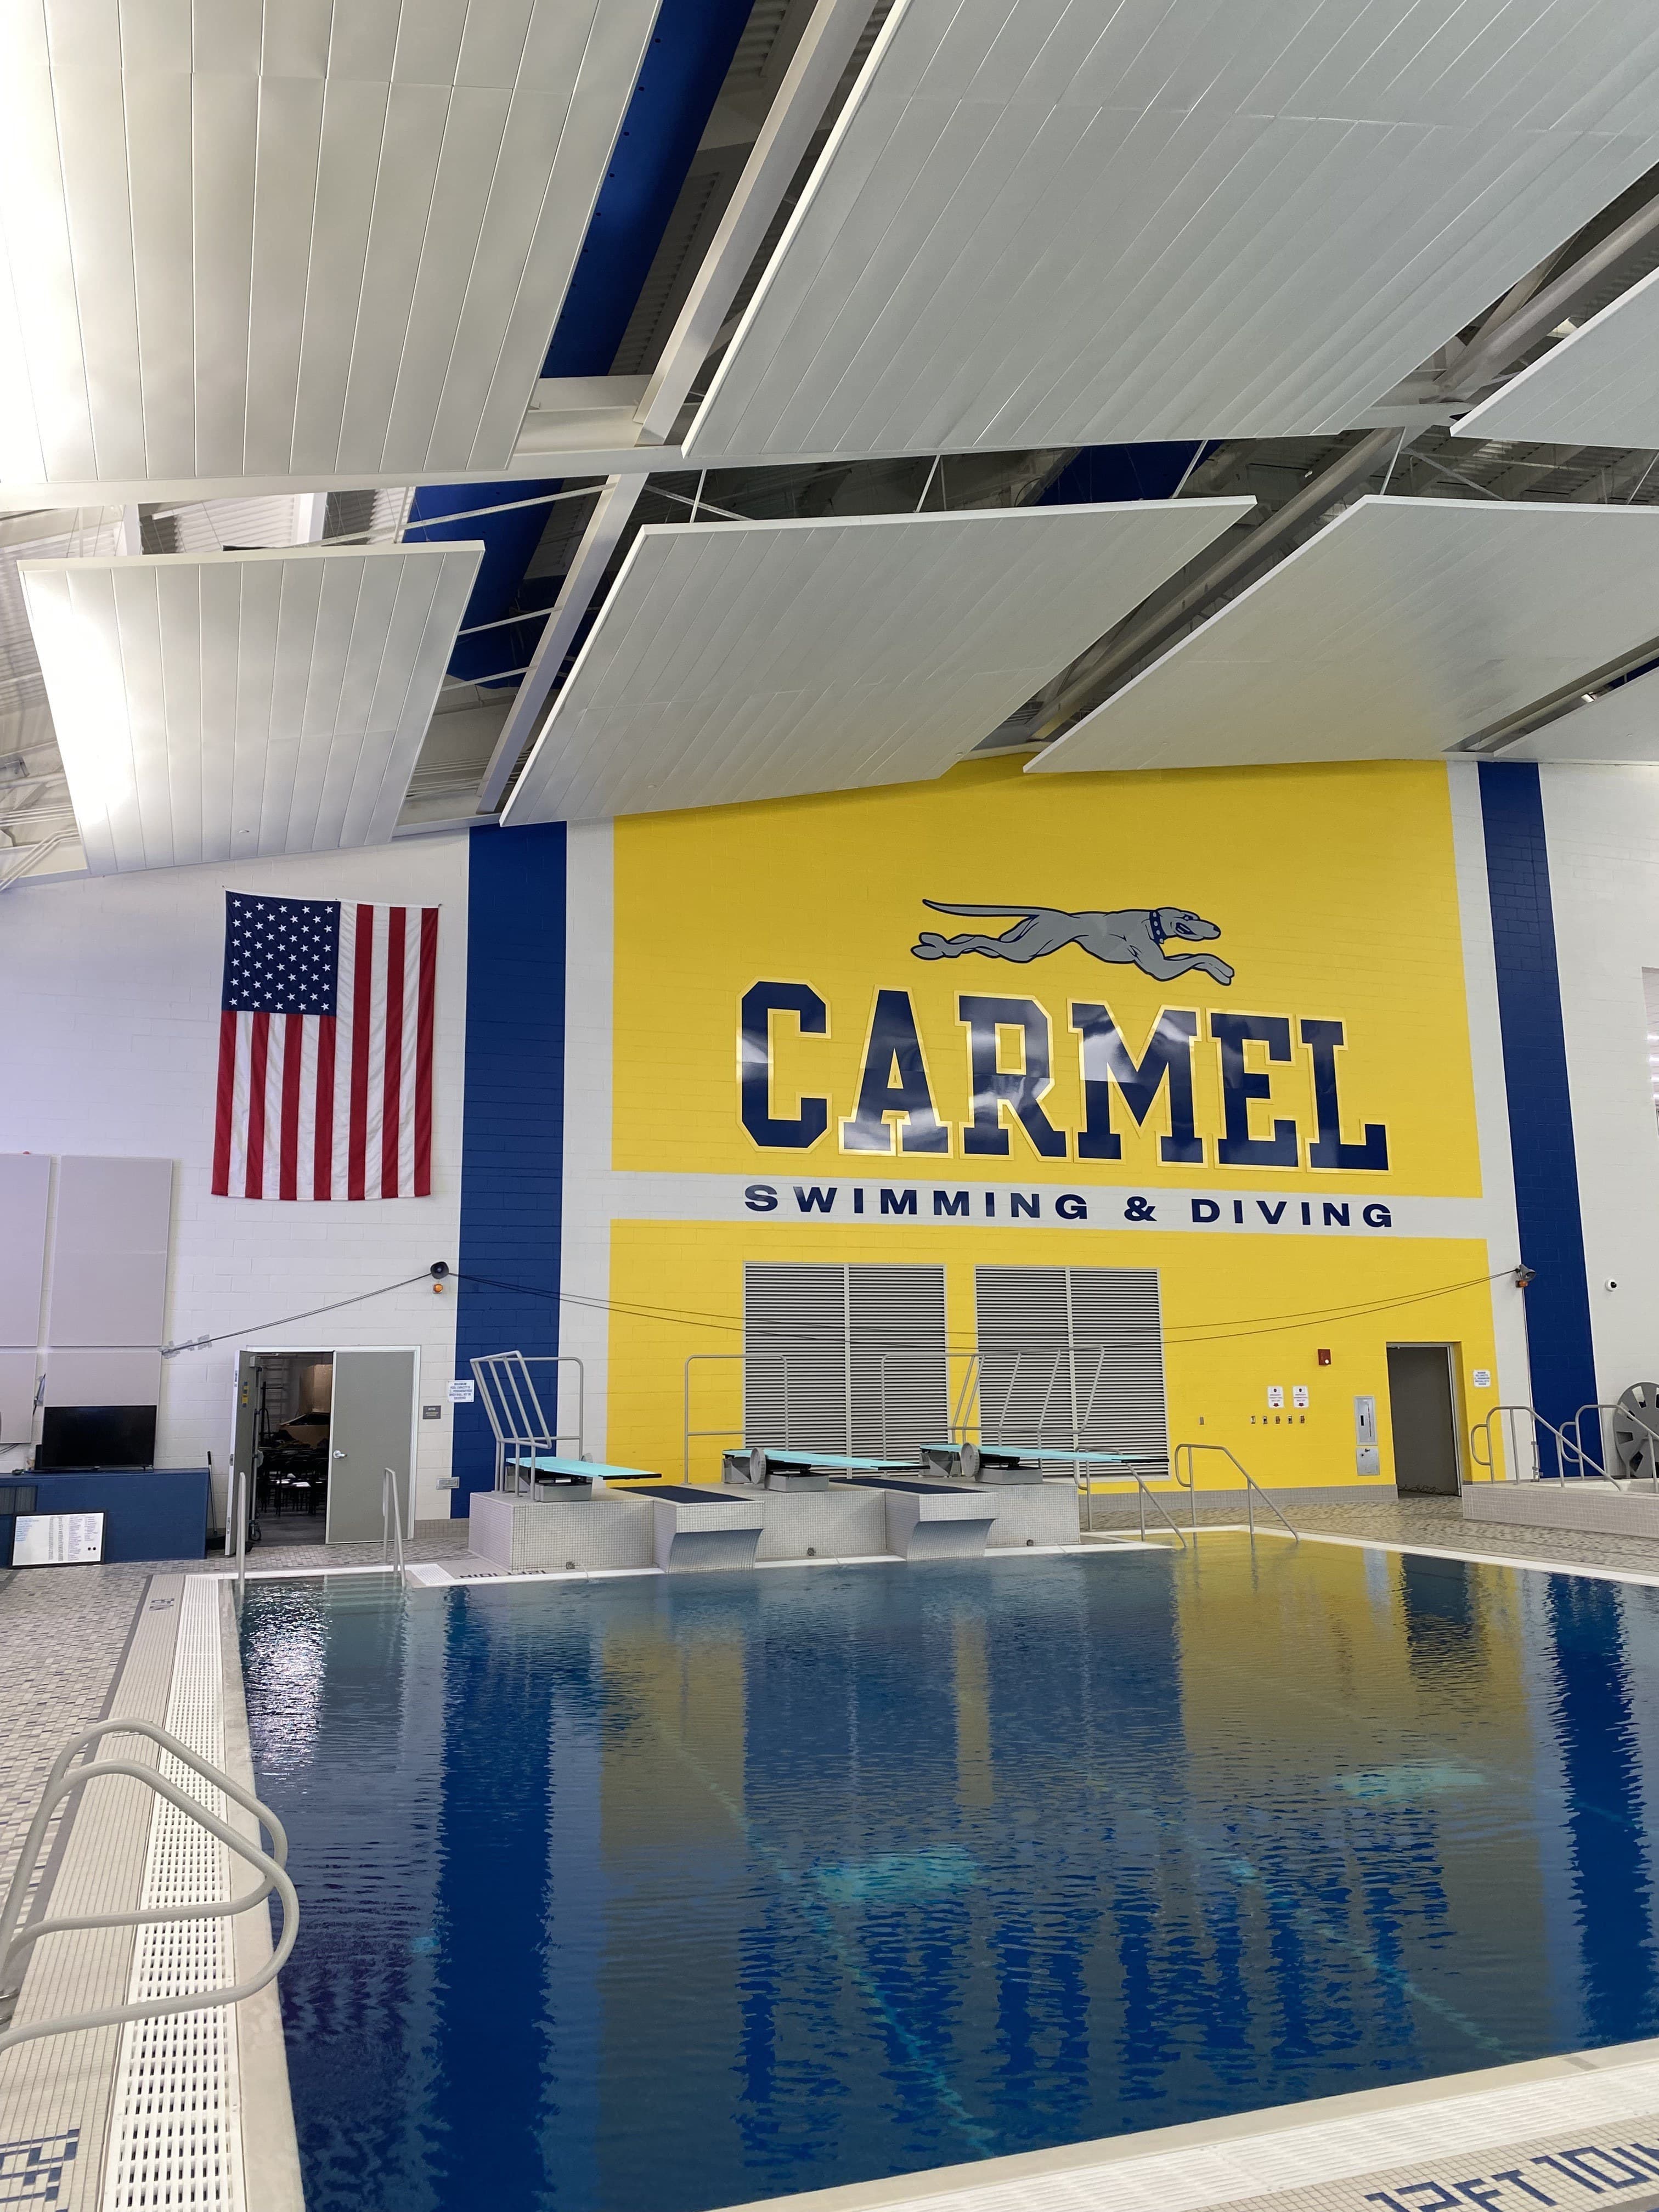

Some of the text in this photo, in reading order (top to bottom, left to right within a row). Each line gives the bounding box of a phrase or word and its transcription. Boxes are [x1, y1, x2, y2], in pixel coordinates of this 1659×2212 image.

[737, 978, 1391, 1173] CARMEL
[744, 1184, 1394, 1228] SWIMMING & DIVING
